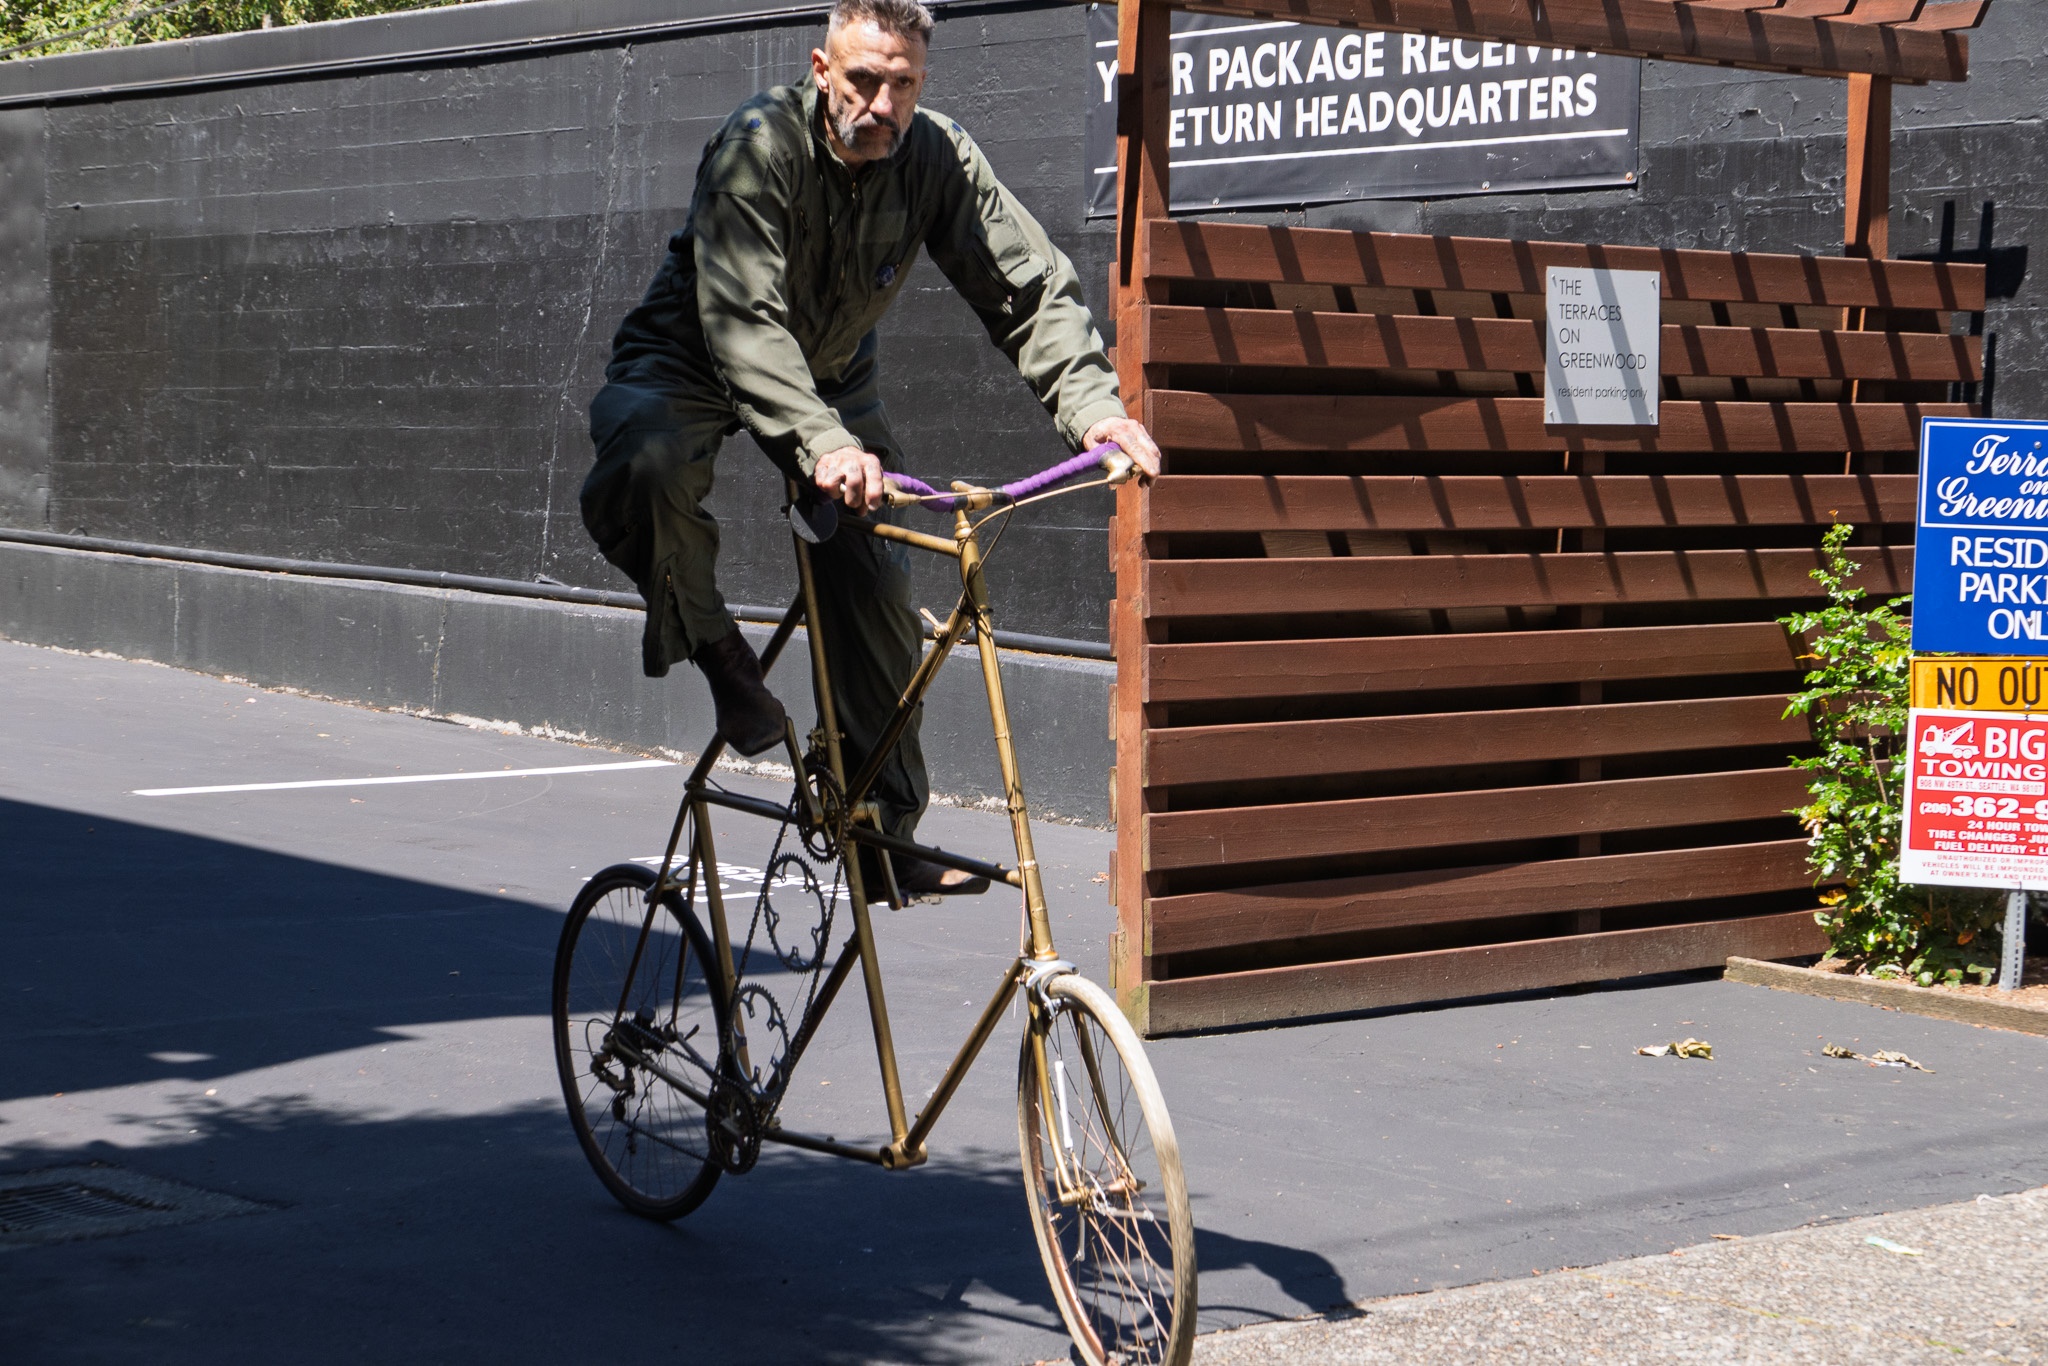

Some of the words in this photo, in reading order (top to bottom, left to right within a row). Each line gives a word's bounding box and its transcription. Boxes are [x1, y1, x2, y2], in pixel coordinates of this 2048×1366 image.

[1208, 32, 1385, 92] PACKAGE
[1168, 100, 1282, 148] ETURN
[1295, 72, 1598, 138] HEADQUARTERS
[1559, 279, 1582, 296] THE
[1559, 303, 1622, 321] TERRACES
[1559, 328, 1581, 345] ON
[1558, 352, 1647, 370] GREENWOOD
[1558, 386, 1593, 397] resident
[1595, 386, 1628, 400] parking
[1629, 387, 1648, 400] only
[2019, 480, 2048, 496] on
[1951, 536, 2048, 569] RESID
[1987, 608, 2048, 641] ONL
[1937, 666, 1979, 706] NO
[1999, 666, 2048, 706] OU
[1984, 726, 2046, 761] BIG
[1921, 758, 2047, 780] TOWING
[1934, 779, 1945, 788] NW
[2010, 783, 2020, 792] WA
[1967, 820, 1984, 830] 24
[1986, 821, 2021, 831] HOUR
[1927, 829, 1956, 839] TIRE
[1958, 831, 2017, 842] CHANGES
[1934, 841, 1965, 851] FUEL
[1968, 843, 2028, 854] DELIVERY
[1937, 854, 1998, 863] UNAUTHORIZED
[1922, 861, 1959, 869] VEHICLES
[1997, 865, 2044, 874] IMPOUNDED
[1942, 870, 1978, 878] OWNER'S
